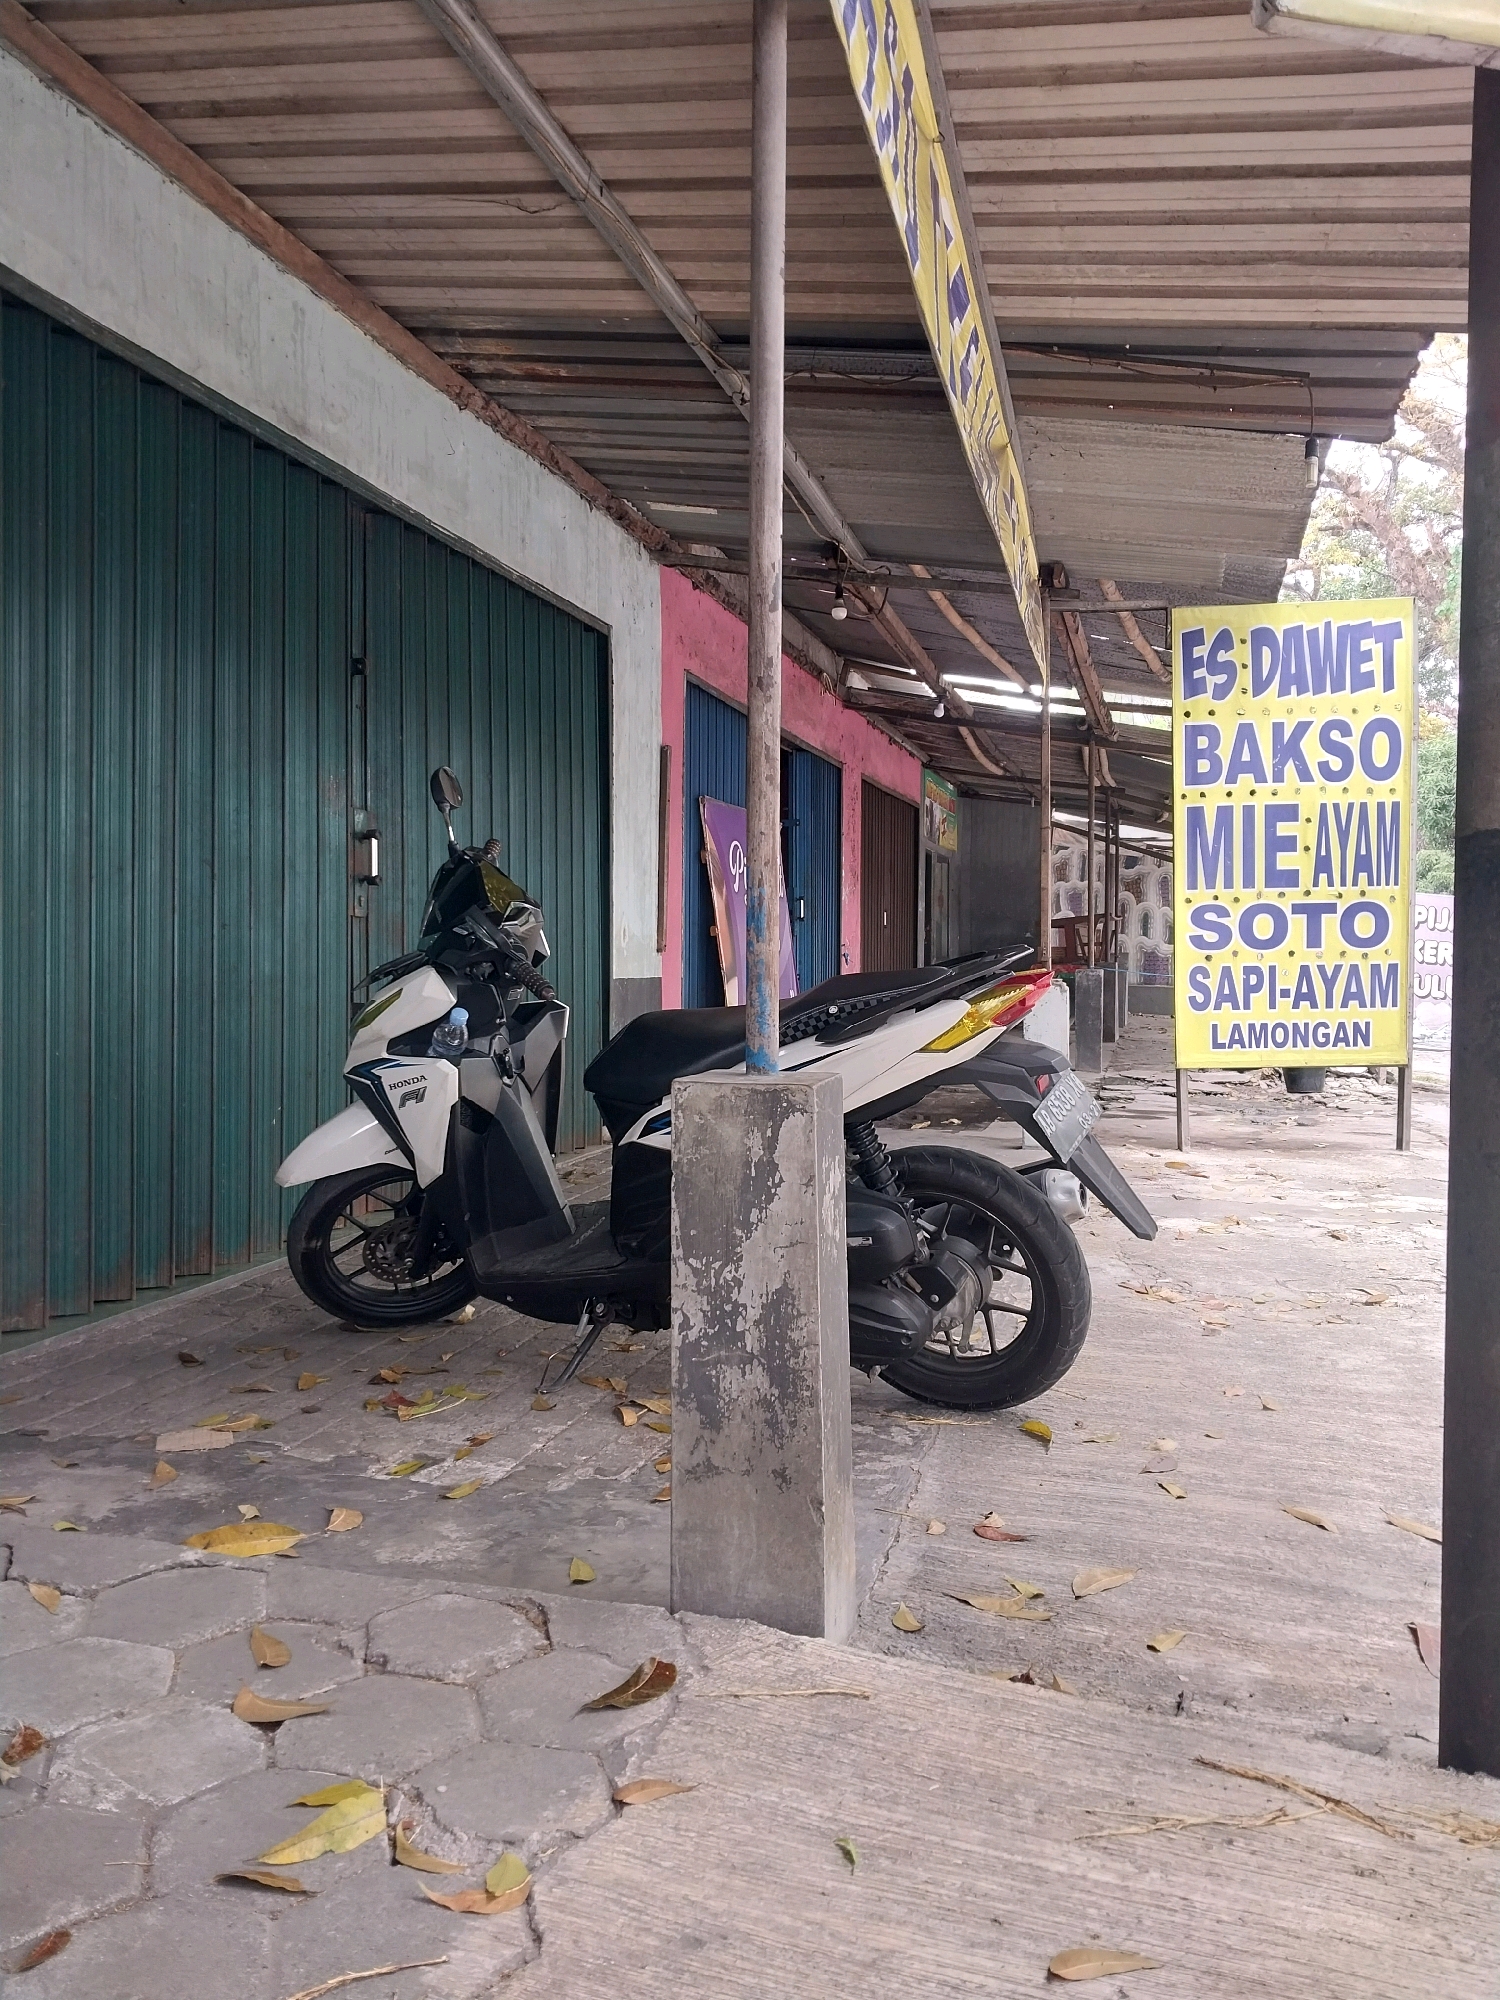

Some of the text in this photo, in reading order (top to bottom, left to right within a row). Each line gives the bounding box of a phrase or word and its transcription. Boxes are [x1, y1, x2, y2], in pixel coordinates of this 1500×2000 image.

[1180, 619, 1403, 702] ES DAWET
[1183, 717, 1402, 788] BAKSO
[1184, 800, 1400, 891] MIE AYAM
[1188, 901, 1391, 952] SOTO
[1415, 904, 1453, 933] PIJ
[1187, 961, 1399, 1012] SAPI-AYAM
[1210, 1020, 1372, 1050] LAMONGAN
[388, 1074, 428, 1091] HONDA
[1037, 1109, 1056, 1138] AB
